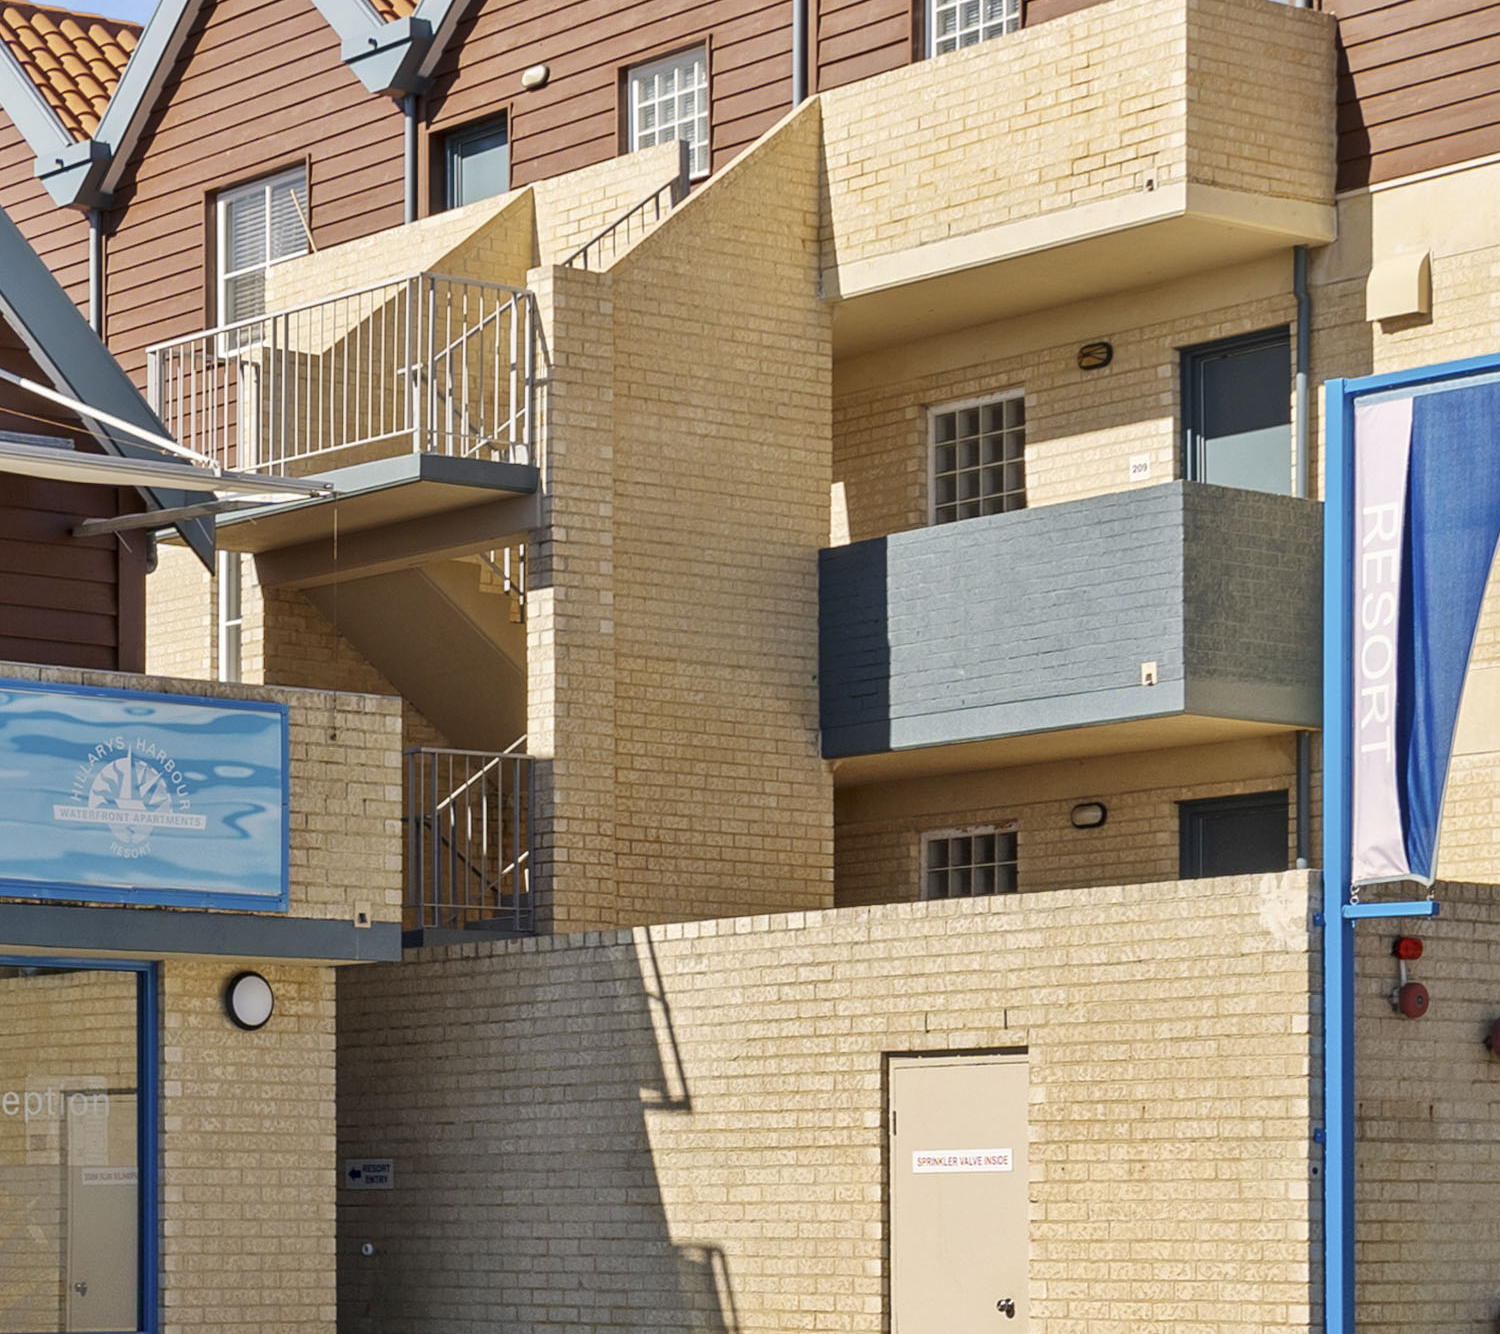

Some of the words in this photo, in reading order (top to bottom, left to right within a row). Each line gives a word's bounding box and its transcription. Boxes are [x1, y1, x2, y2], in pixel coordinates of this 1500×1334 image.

[1361, 502, 1399, 763] RESORT
[70, 735, 126, 802] HILLARYS
[136, 737, 191, 810] HARBOUR
[59, 808, 130, 823] WATERFRONT
[133, 814, 202, 827] APARTMENTS
[110, 841, 153, 859] RESORT
[917, 1156, 958, 1167] SPRINKLER
[959, 1156, 982, 1166] VALVE
[984, 1155, 1008, 1165] INSIDE
